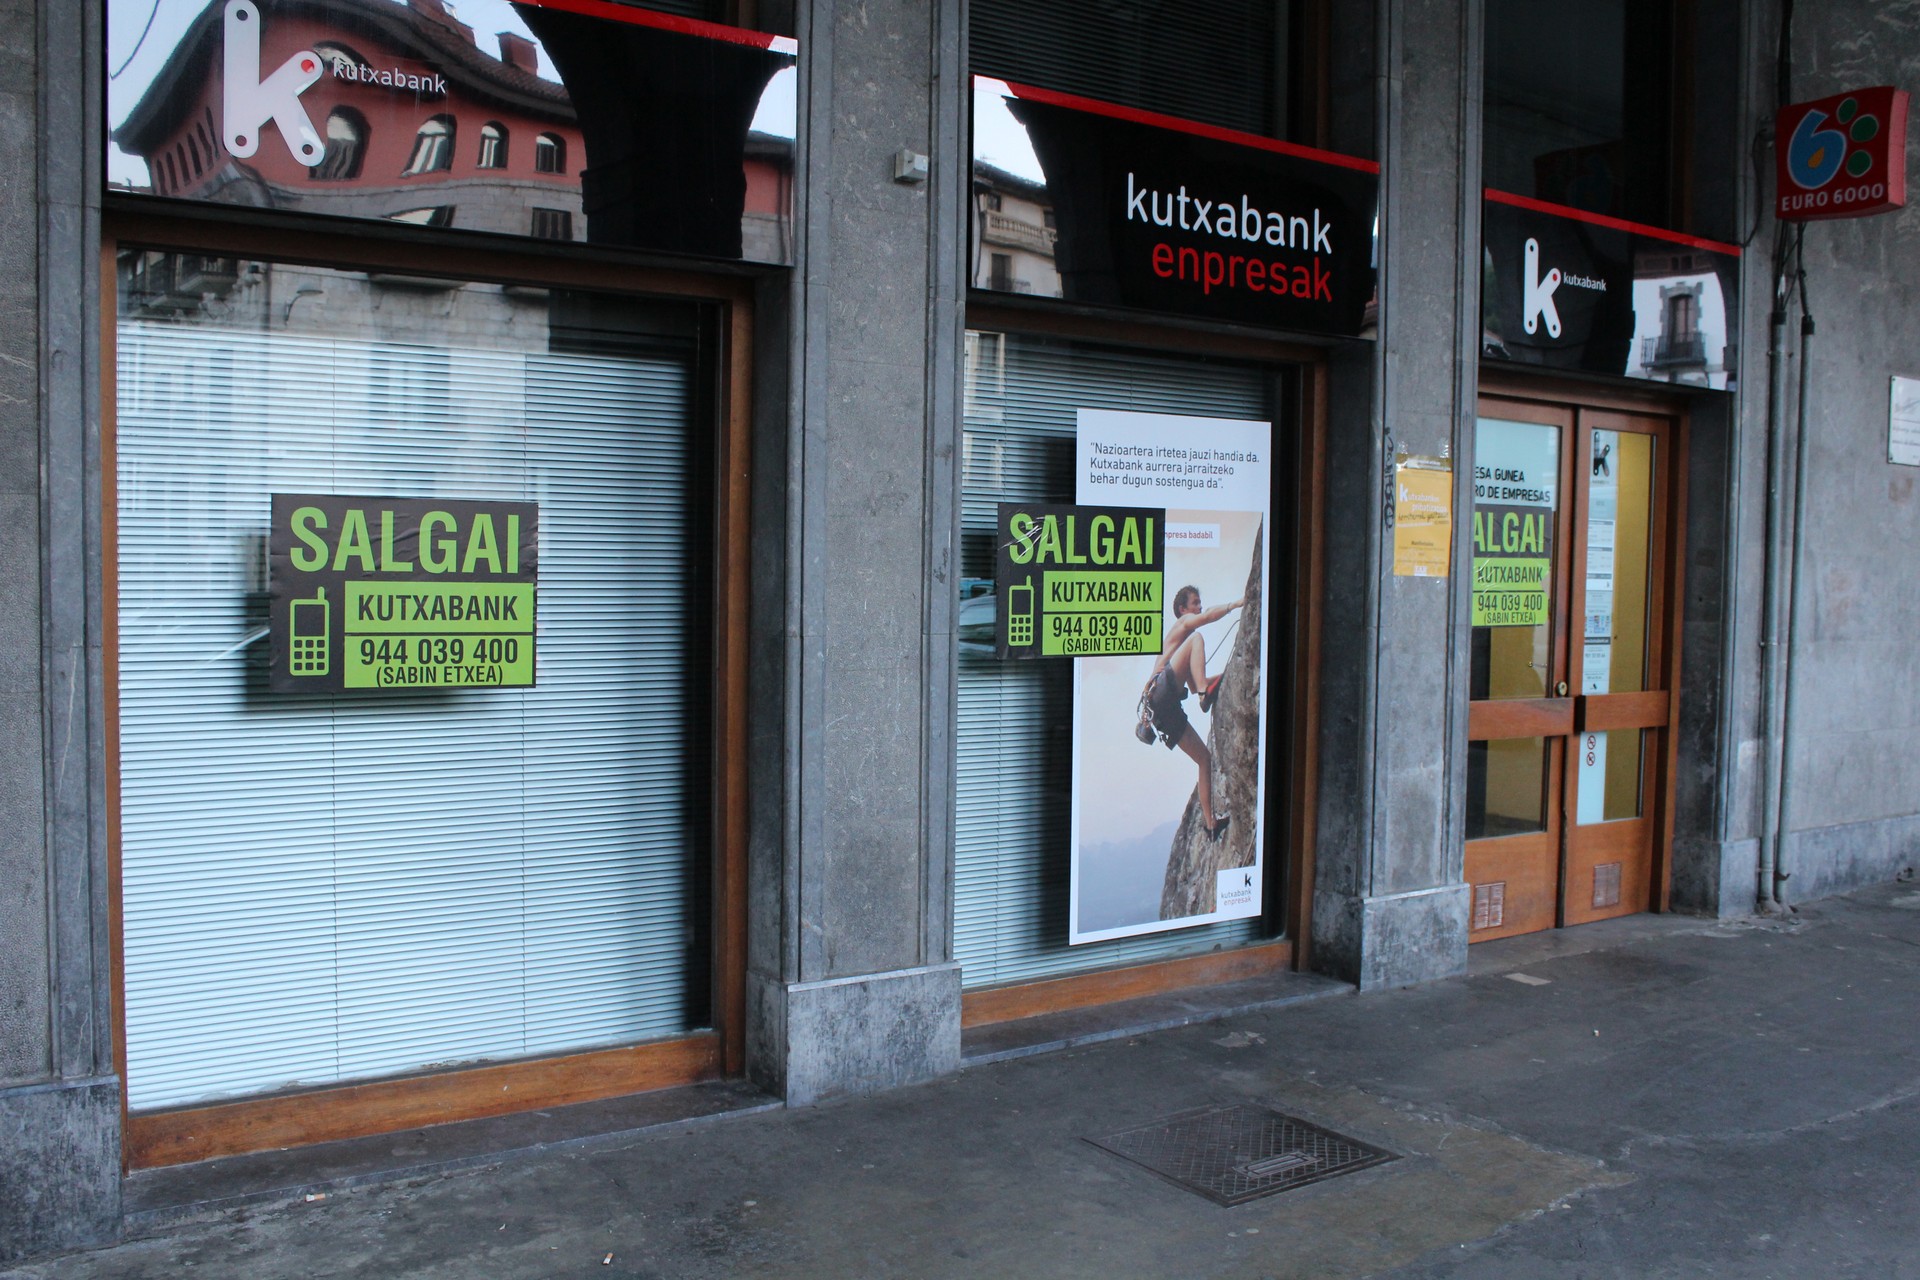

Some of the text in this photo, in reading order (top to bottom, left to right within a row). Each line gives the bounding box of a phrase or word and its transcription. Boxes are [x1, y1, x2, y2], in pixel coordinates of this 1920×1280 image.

[332, 57, 447, 95] kutxabank
[1781, 183, 1885, 212] EURO 6000
[1127, 172, 1332, 254] kutxabank
[1152, 243, 1332, 302] enpresak
[1563, 271, 1607, 291] kutxabank
[1155, 446, 1187, 459] irtetea
[1188, 448, 1211, 462] jauzi
[1213, 450, 1244, 462] handia
[1246, 452, 1260, 463] da.
[1090, 458, 1234, 476] Kutxabank aurrera jarraitzeko
[1494, 468, 1525, 482] GUNEA
[1090, 473, 1120, 485] behar
[1122, 474, 1153, 489] dugun
[1155, 477, 1204, 490] sostengua
[1487, 486, 1500, 499] DE
[1502, 488, 1551, 503] EMPRESAS
[290, 507, 519, 574] SALGAI
[1009, 513, 1154, 565] SALGAI
[1189, 530, 1213, 539] badabil
[1477, 566, 1543, 584] KUTXABANK
[1052, 581, 1152, 603] KUTXABANK
[358, 594, 518, 621] KUTXABANK
[1478, 594, 1543, 612] 944 039 400
[1053, 615, 1152, 637] 944 039 400
[1483, 611, 1536, 624] (SABIN ETXEA)
[360, 638, 518, 665] 944 039 400
[1062, 636, 1143, 655] (SABIN ETXEA)
[376, 665, 503, 687] (SABIN ETXEA)
